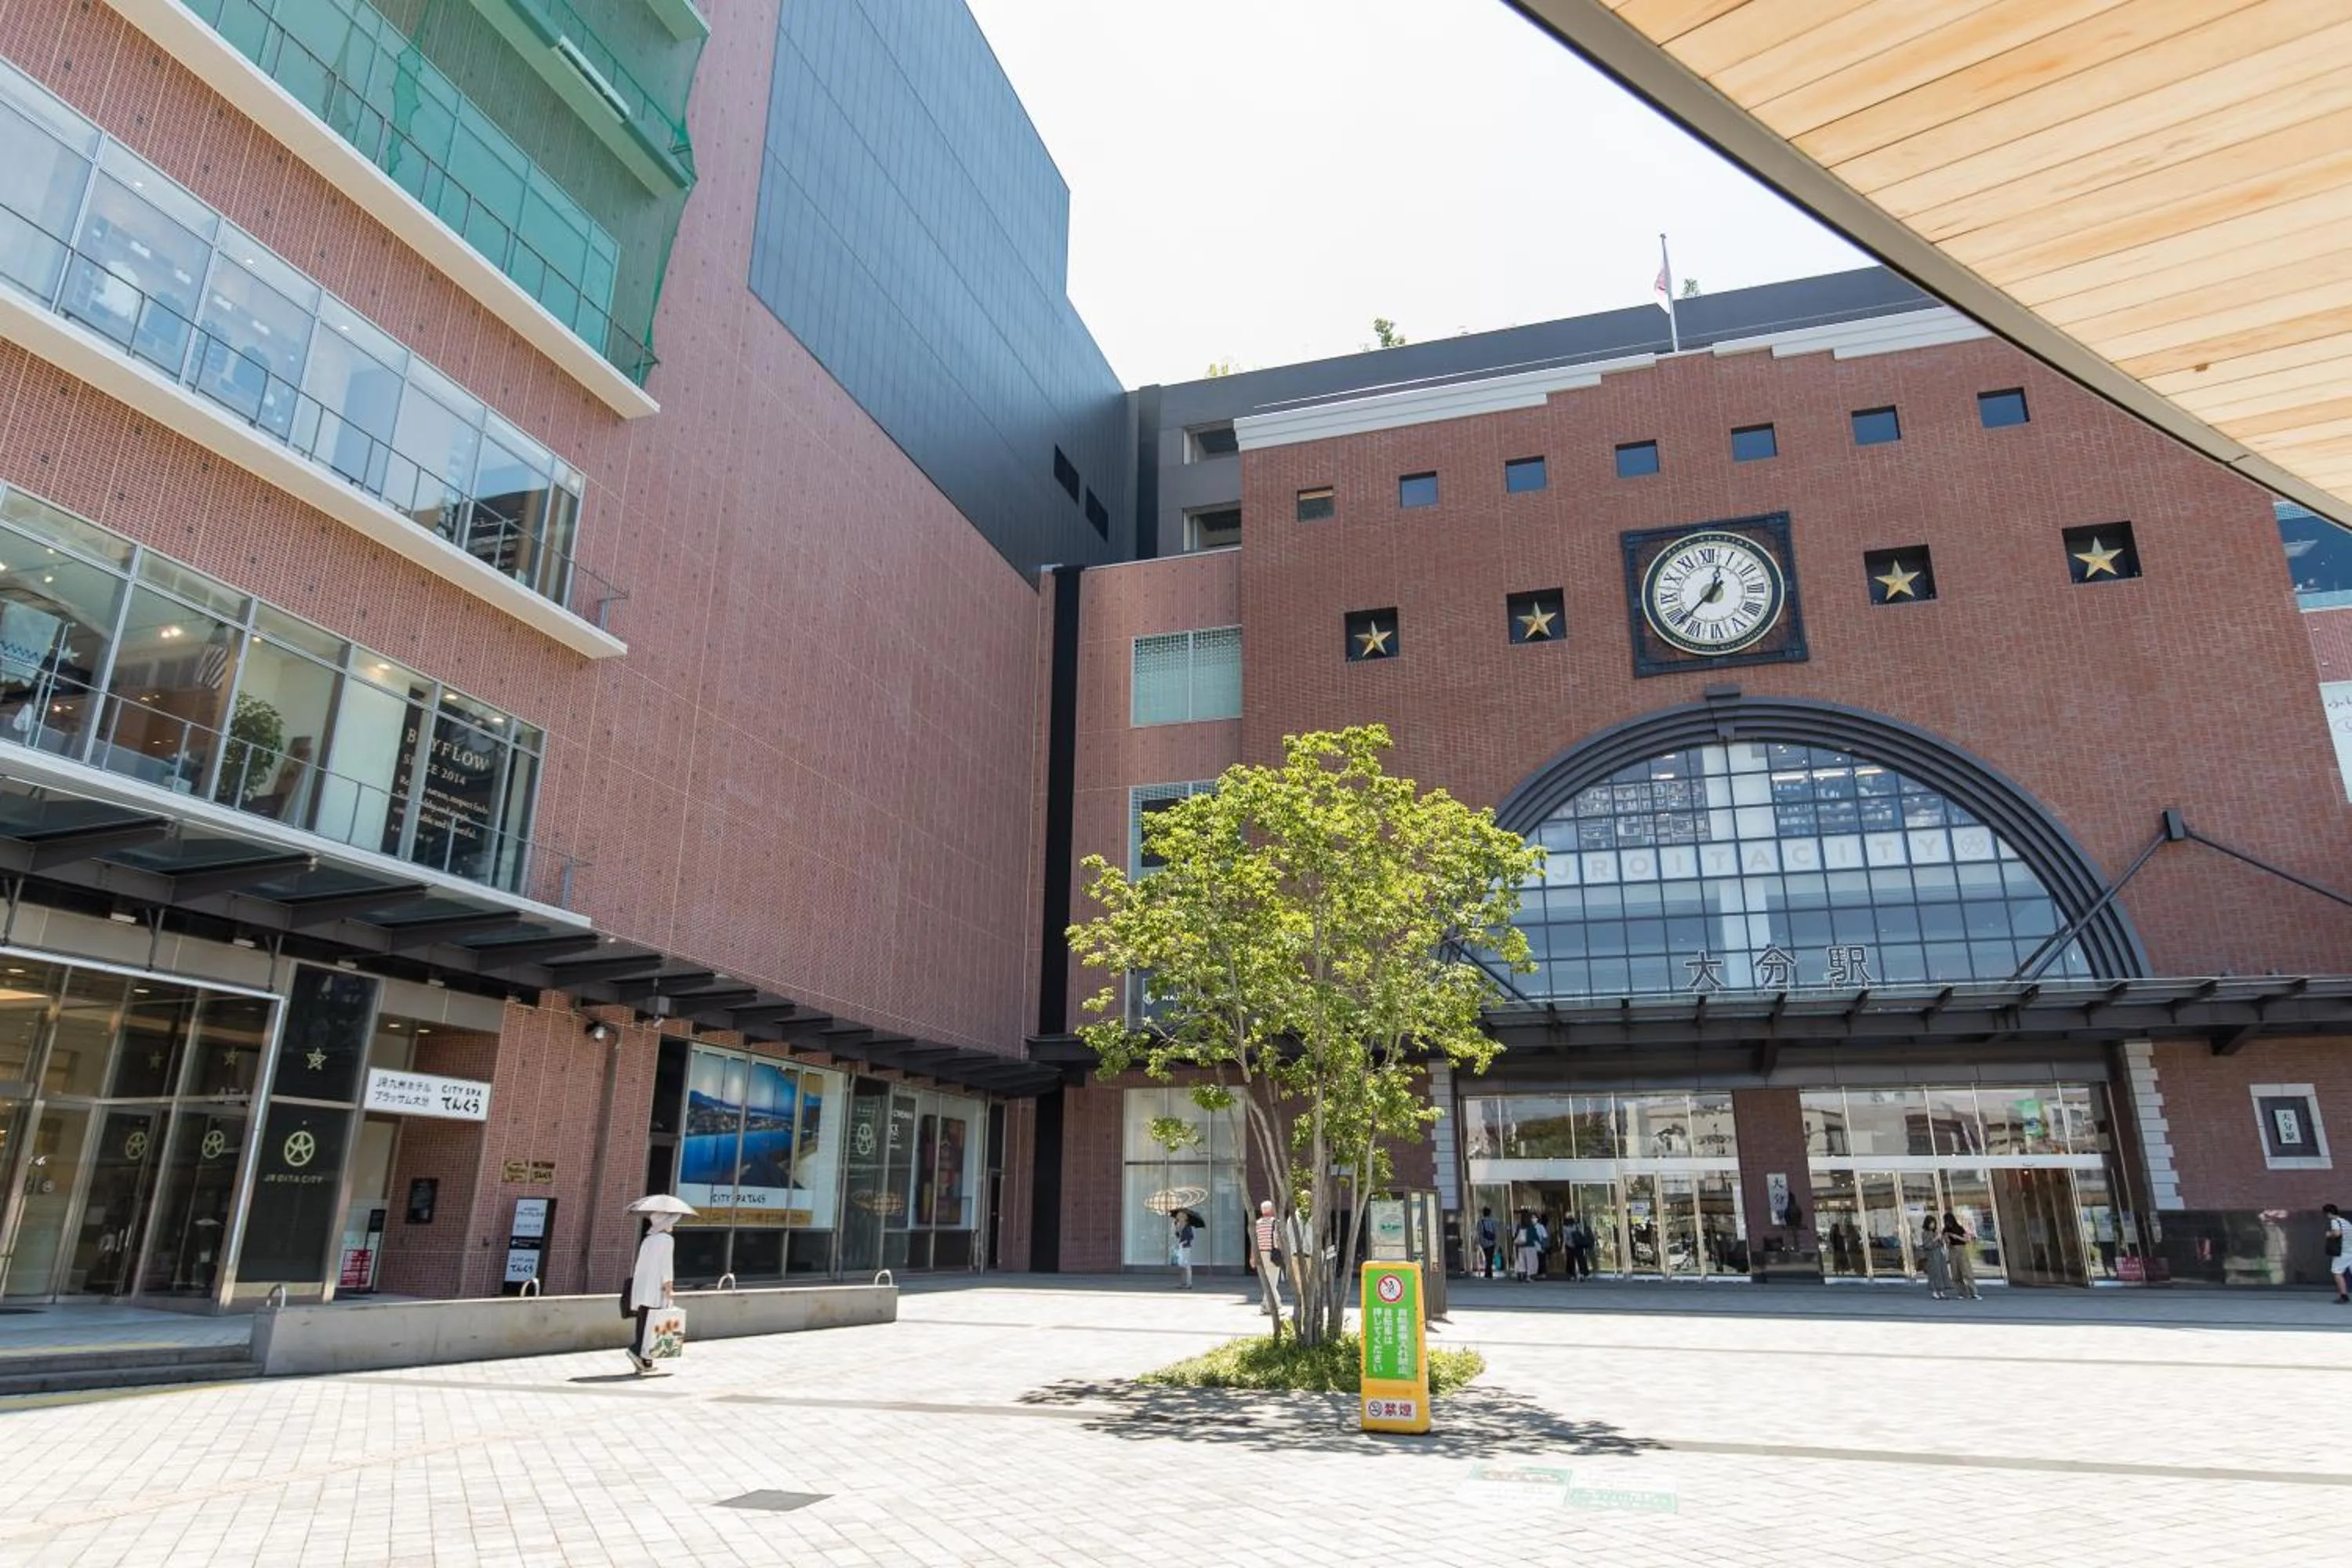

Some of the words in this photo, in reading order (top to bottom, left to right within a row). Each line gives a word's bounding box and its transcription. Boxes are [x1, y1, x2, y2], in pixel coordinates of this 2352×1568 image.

[406, 728, 490, 771] BYFLOW
[441, 768, 466, 785] 2014
[1685, 945, 1872, 990] 大分駅
[441, 1084, 463, 1094] CITY
[441, 1097, 480, 1113] てんくう
[712, 1192, 730, 1203] CITY
[1385, 1403, 1411, 1417] 禁煙
